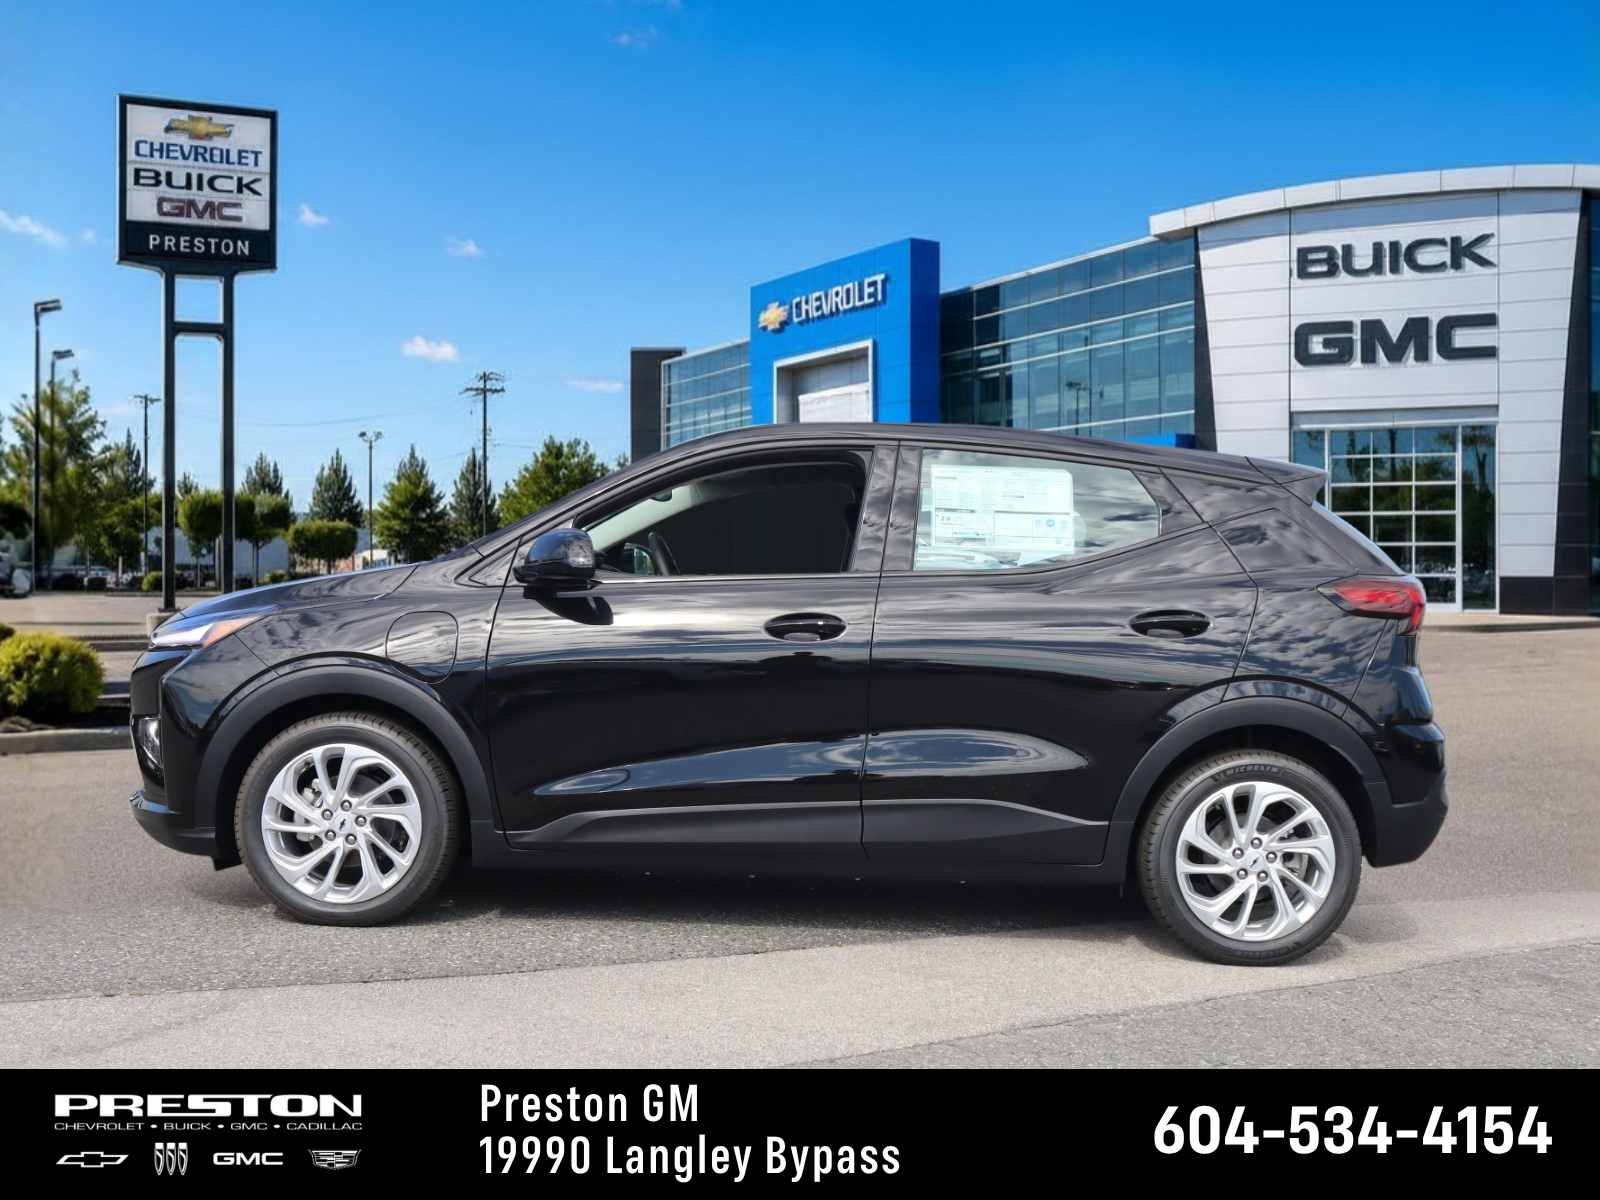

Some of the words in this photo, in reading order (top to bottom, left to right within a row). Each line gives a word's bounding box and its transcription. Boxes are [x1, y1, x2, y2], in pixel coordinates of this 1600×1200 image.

[134, 139, 263, 167] CHEVROLET
[133, 167, 263, 197] BUICK
[156, 196, 243, 222] GMC
[149, 234, 250, 256] PRESTON
[1296, 232, 1497, 280] BUICK
[792, 273, 886, 323] CHEVROLET
[1294, 312, 1499, 366] GMC
[1226, 764, 1279, 777] MICHELIN
